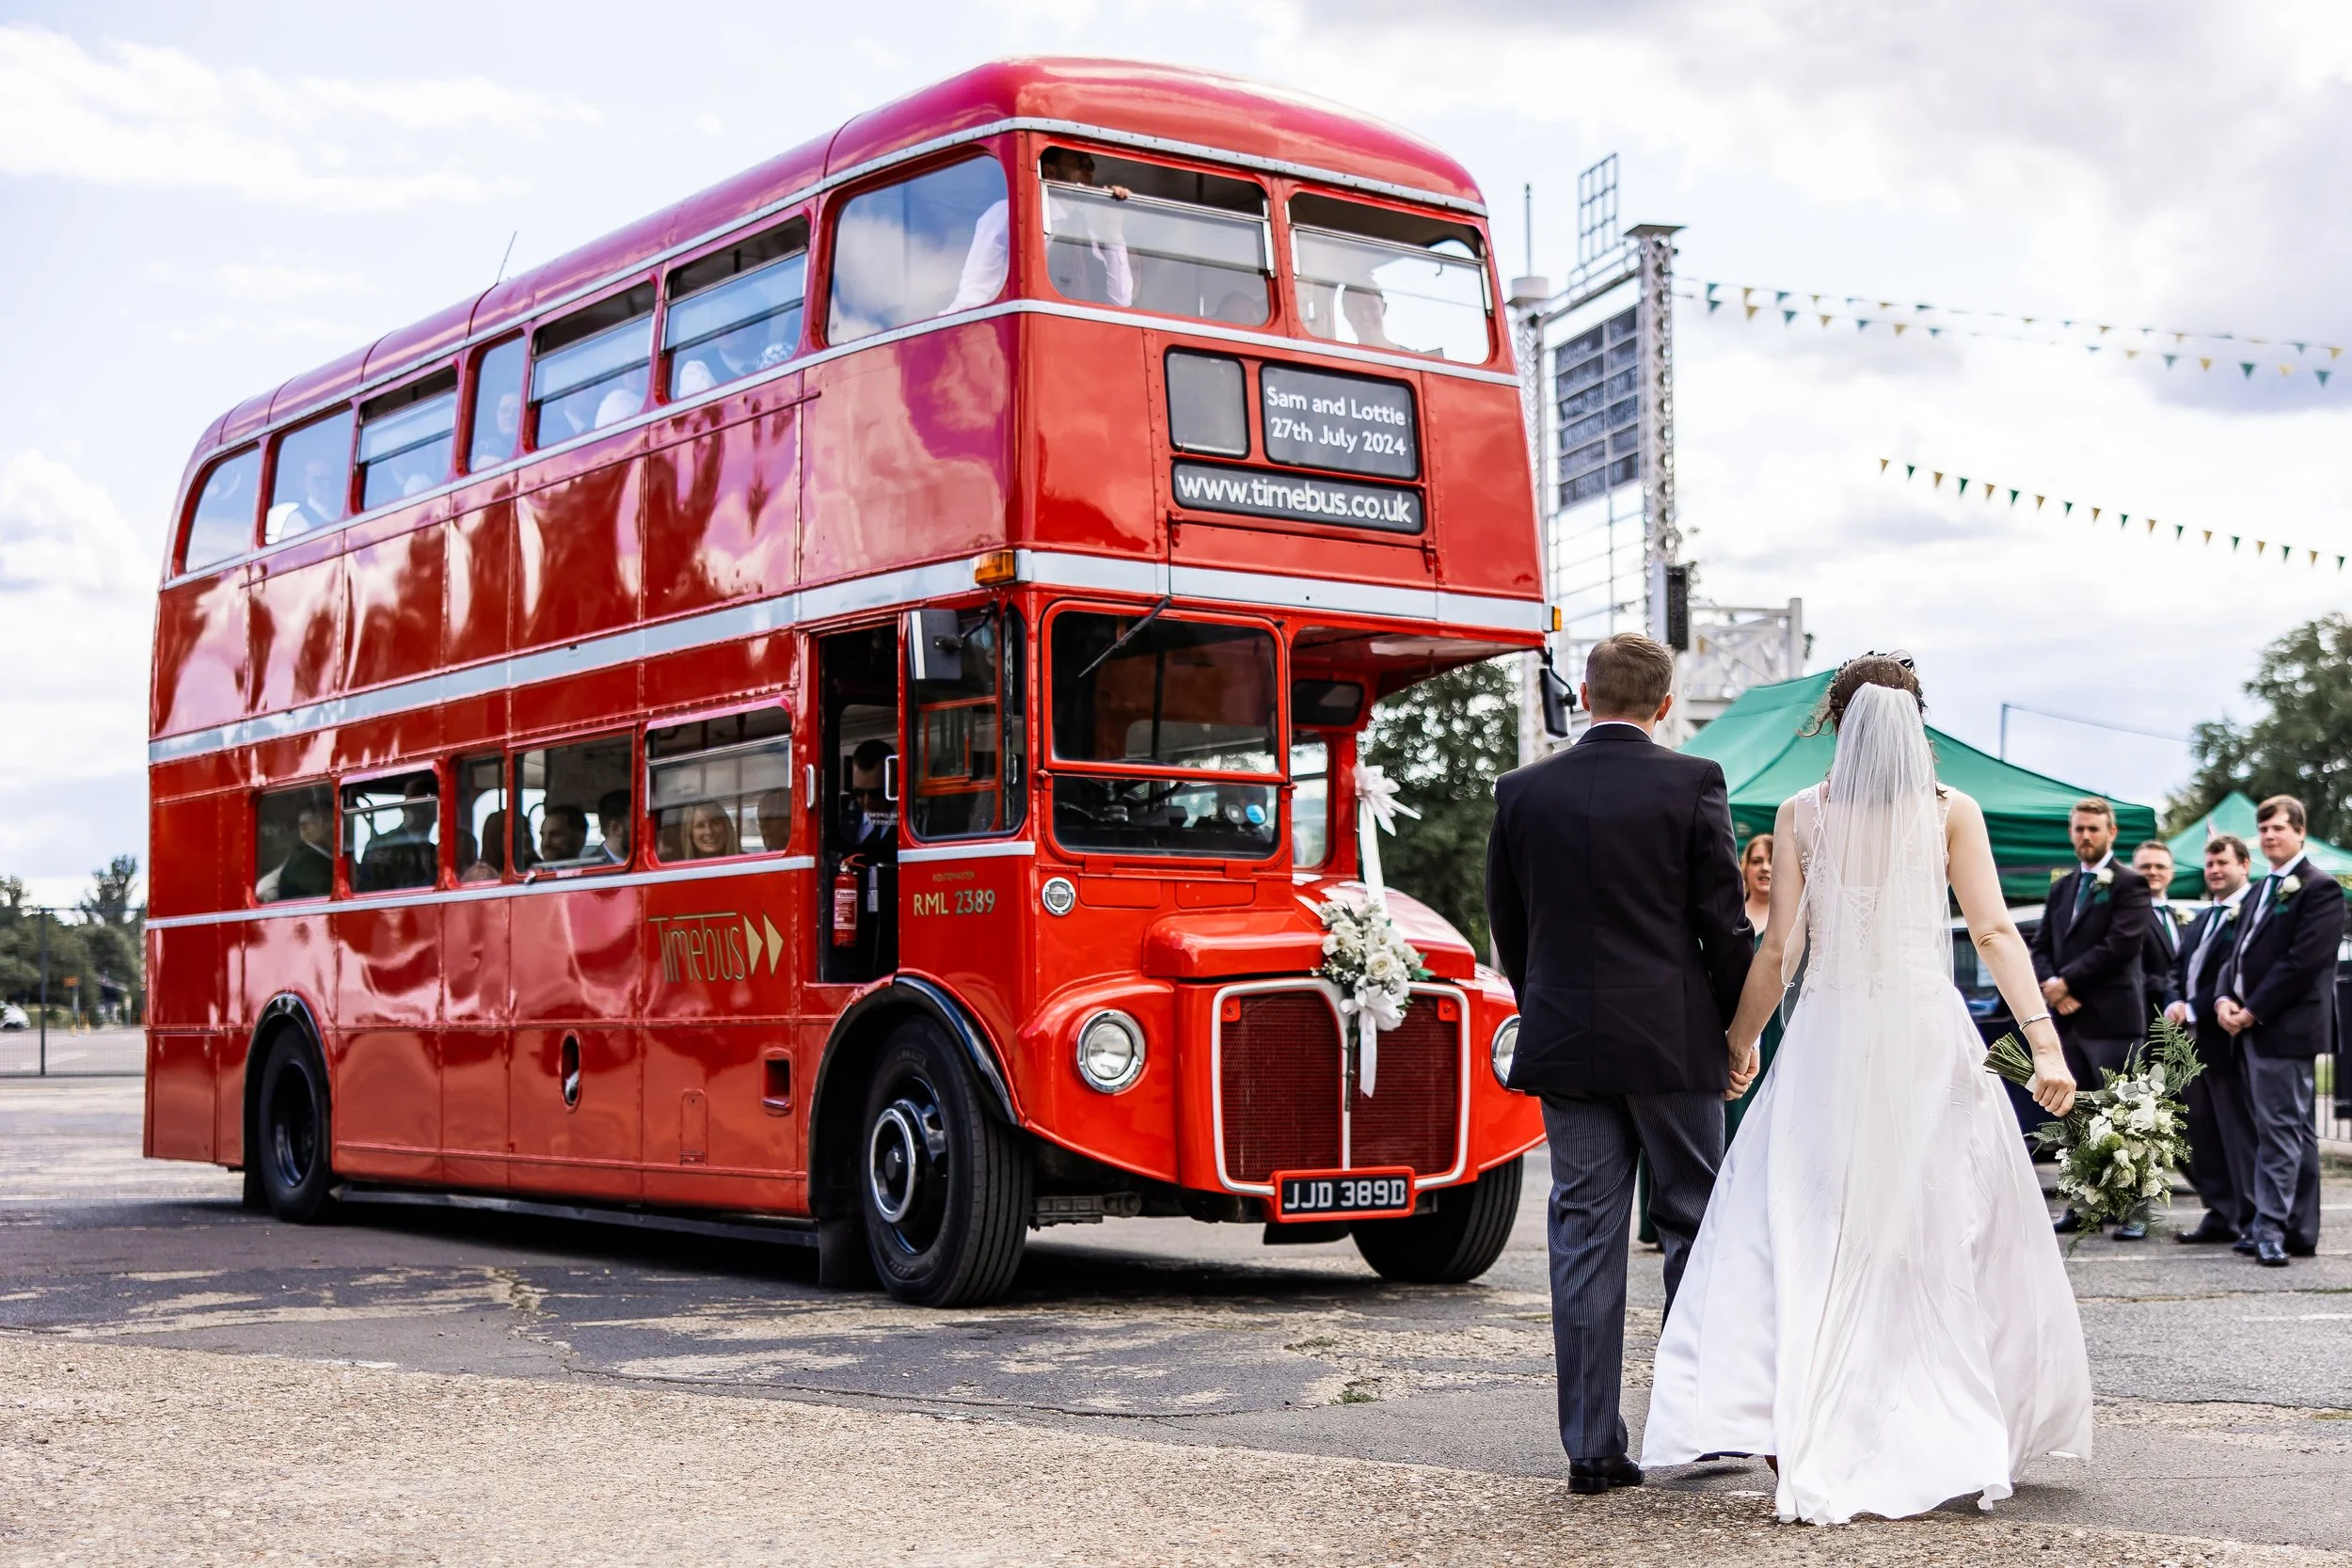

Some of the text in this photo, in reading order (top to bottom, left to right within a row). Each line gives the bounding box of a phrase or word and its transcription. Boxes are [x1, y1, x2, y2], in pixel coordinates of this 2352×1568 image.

[1266, 386, 1406, 426] Sam and Lottie
[1270, 417, 1406, 456] 27th July 2024
[1178, 474, 1412, 524] www.timebus.co.uk
[914, 888, 995, 916] RML 2389
[1283, 1179, 1406, 1210] JJD 389D
